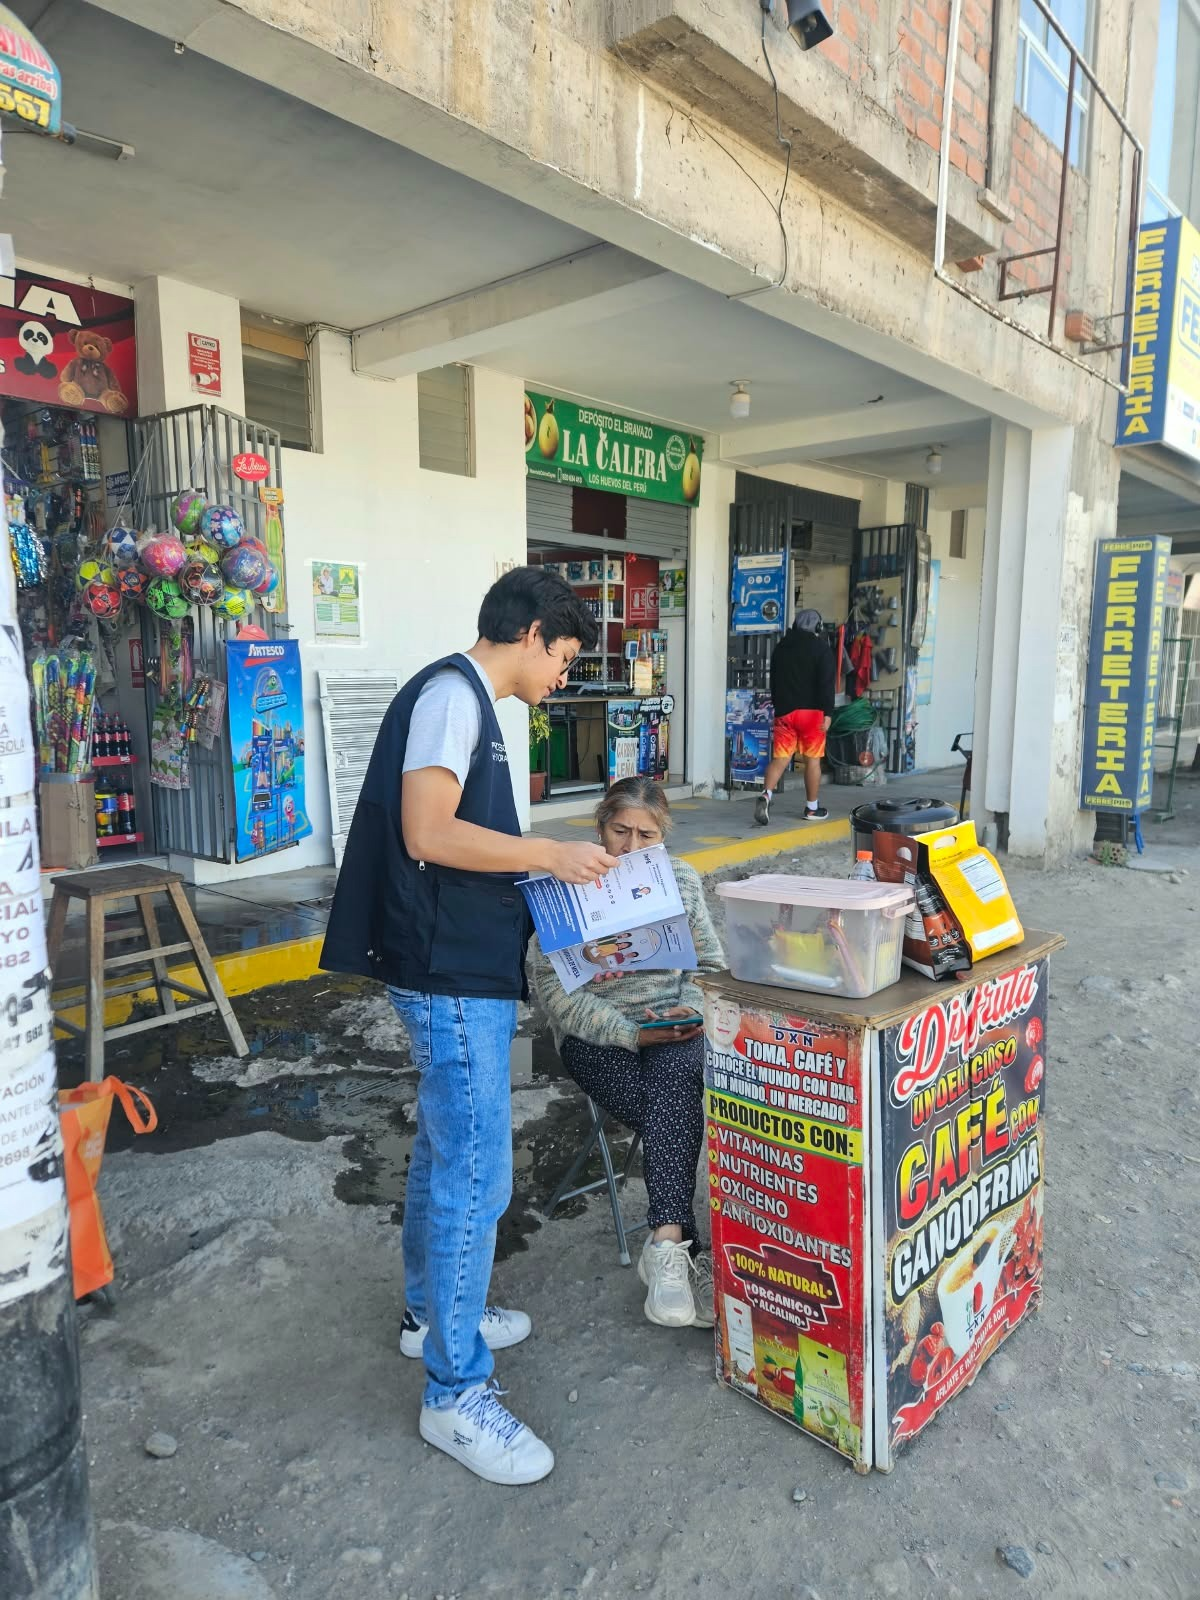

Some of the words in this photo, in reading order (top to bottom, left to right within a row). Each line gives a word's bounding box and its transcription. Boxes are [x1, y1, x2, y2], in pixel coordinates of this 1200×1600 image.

[1124, 228, 1167, 436] FERRETERIA
[578, 409, 613, 429] DEPÓSITO
[614, 419, 623, 432] EL
[623, 421, 653, 440] BRAVAZO
[562, 429, 589, 467] LA
[596, 434, 667, 482] CALERA
[588, 473, 600, 485] LOS
[600, 475, 622, 489] HUEVOS
[622, 479, 632, 491] DEL
[633, 481, 647, 493] PERÚ
[248, 643, 285, 657] ARTESCO
[1095, 556, 1141, 795] FERRETERIA
[1139, 556, 1167, 794] FERRETERIA
[775, 1030, 814, 1047] DXN
[896, 963, 1039, 1099] Disfruta
[706, 1050, 745, 1075] CONOCE
[746, 1060, 757, 1081] EL
[758, 1064, 801, 1091] MUNDO
[802, 1074, 829, 1097] CON
[744, 1037, 790, 1069] TOMA,
[793, 1048, 834, 1077] CAFÉ
[834, 1056, 846, 1079] Y
[912, 1085, 936, 1127] UN
[935, 1036, 1017, 1109] DELICIOSO
[0, 1074, 46, 1100] ACIÓN
[713, 1070, 728, 1091] UN
[769, 1087, 786, 1109] UN
[787, 1091, 847, 1124] MERCADO
[709, 1093, 806, 1145] PRODUCTOS
[809, 1125, 854, 1158] CON:
[899, 1076, 1010, 1222] CAFÉ
[1010, 1098, 1040, 1142] CON
[717, 1126, 805, 1174] VITAMINAS
[718, 1151, 819, 1205] NUTRIENTES
[719, 1175, 789, 1220] OXIGENO
[720, 1200, 852, 1269] ANTIOXIDANTES
[893, 1139, 1040, 1298] GANODERMA
[735, 1252, 766, 1278] 100%
[768, 1265, 828, 1300] NATURAL
[751, 1283, 812, 1317] ORGANICO
[759, 1299, 801, 1327] ALCALINO
[968, 1310, 986, 1341] DXN
